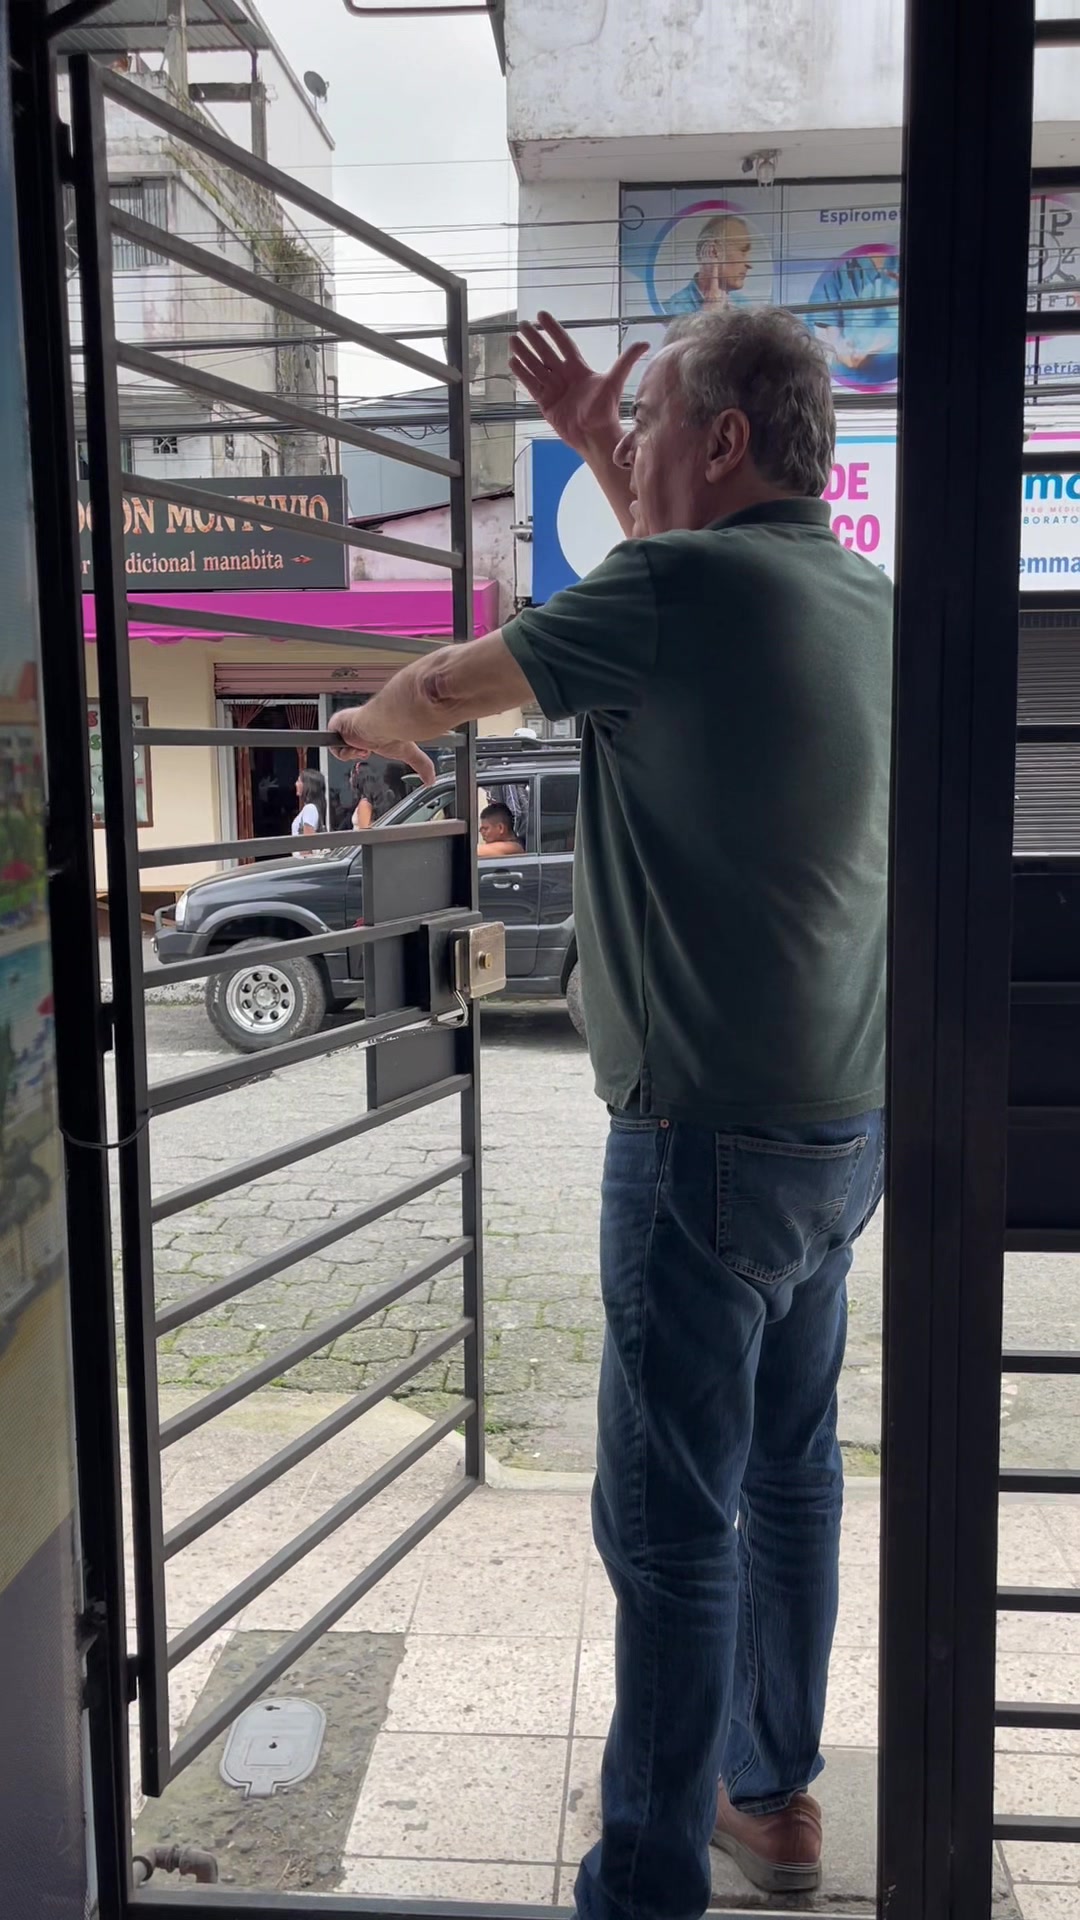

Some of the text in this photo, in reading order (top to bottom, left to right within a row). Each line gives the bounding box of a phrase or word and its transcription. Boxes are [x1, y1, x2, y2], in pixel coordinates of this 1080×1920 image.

[820, 209, 901, 225] Espirome
[821, 462, 870, 501] DE
[203, 549, 283, 573] manabita
